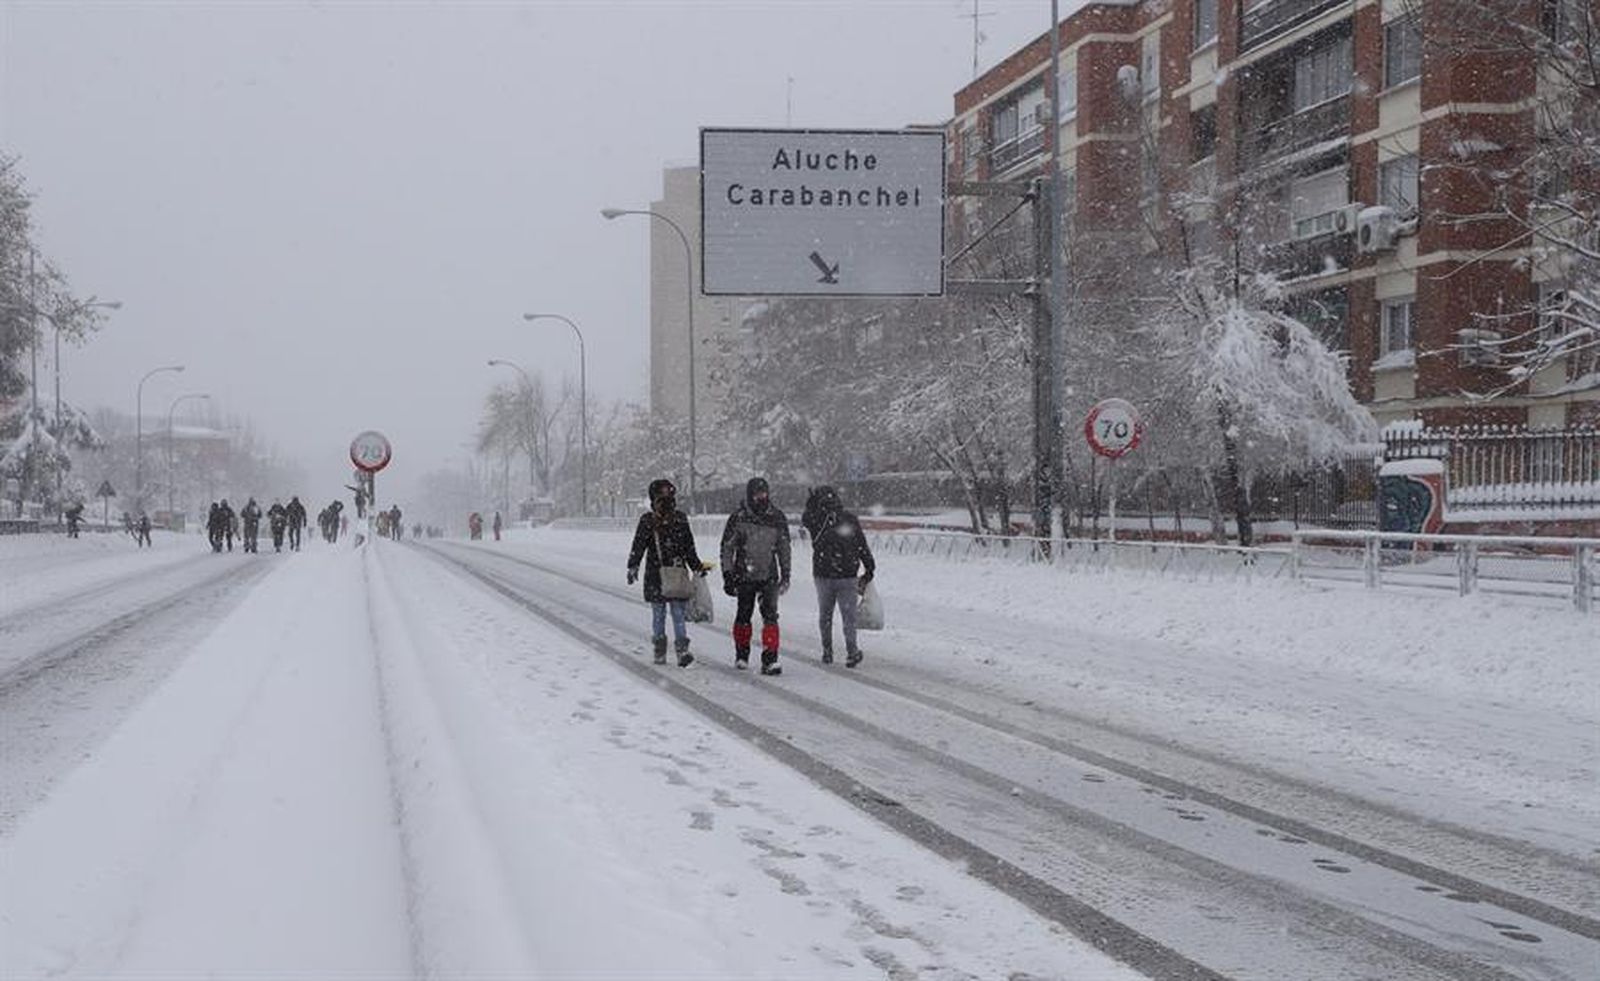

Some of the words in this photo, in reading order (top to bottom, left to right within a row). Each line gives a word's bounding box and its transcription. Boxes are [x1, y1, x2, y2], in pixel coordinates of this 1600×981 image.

[772, 148, 878, 170] Aluche
[727, 183, 921, 207] Carabanchel
[1101, 419, 1128, 438] 70
[361, 445, 382, 459] 70
